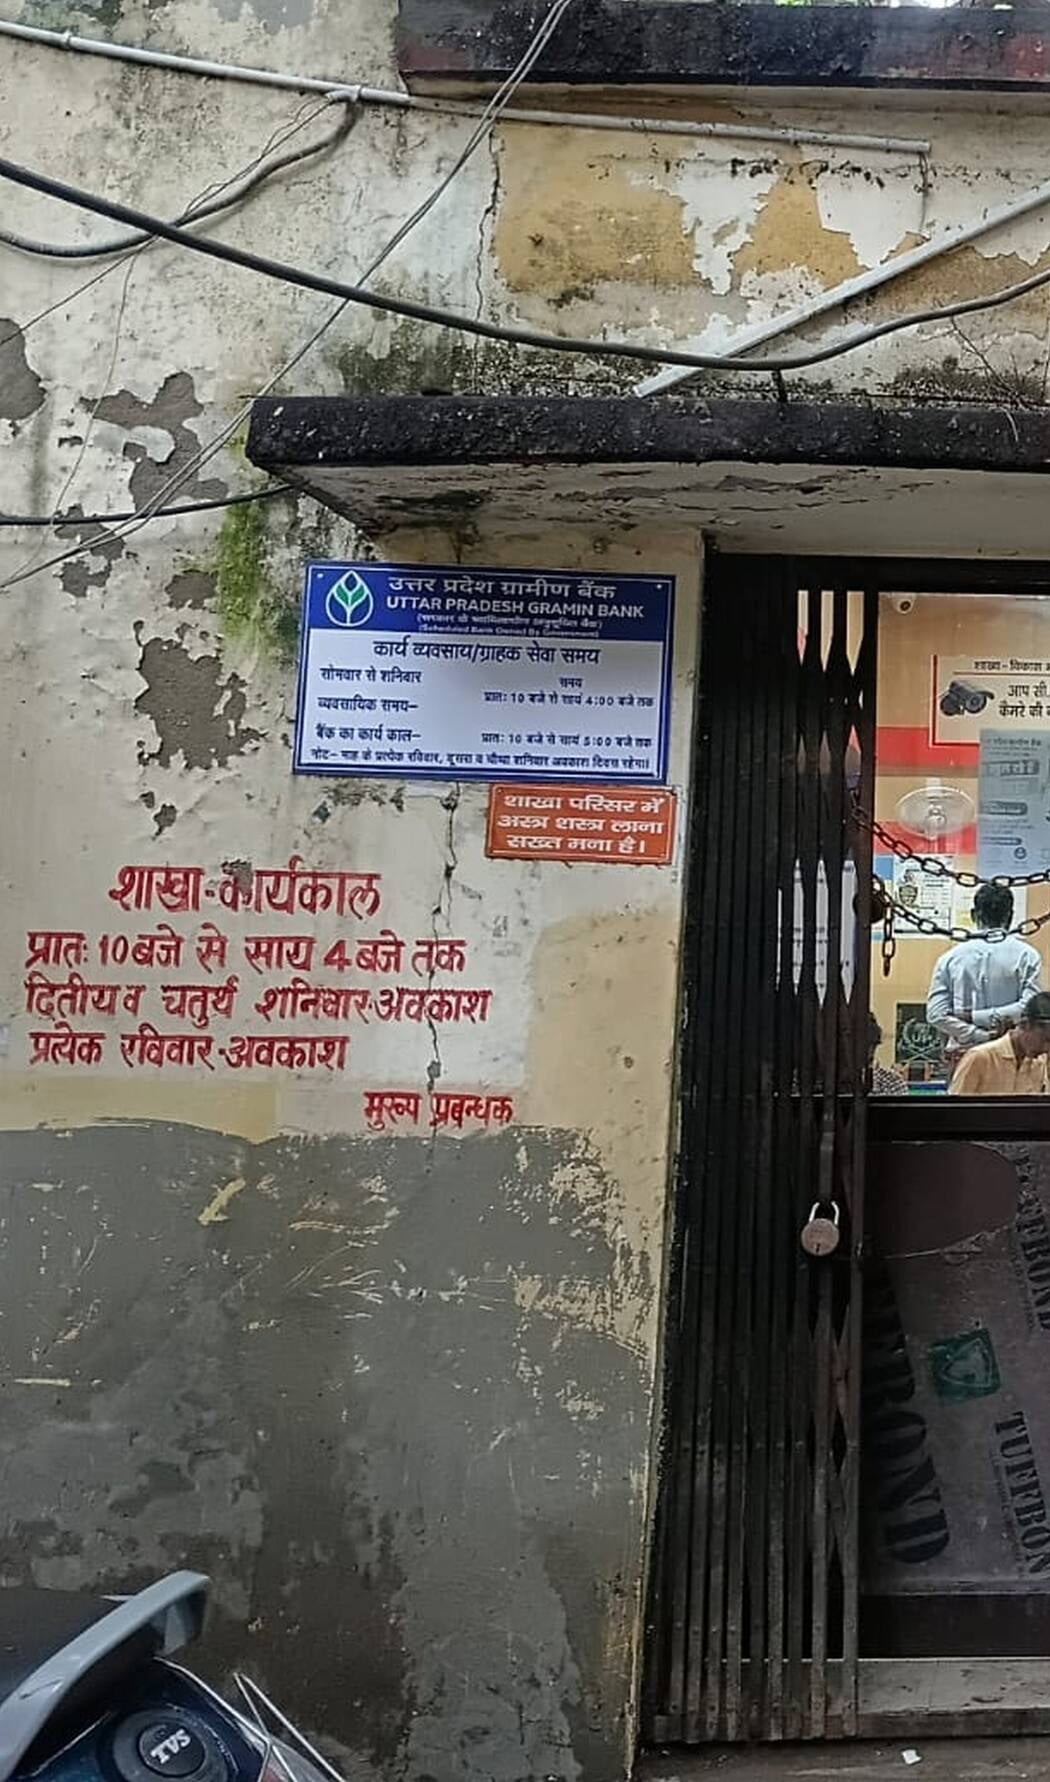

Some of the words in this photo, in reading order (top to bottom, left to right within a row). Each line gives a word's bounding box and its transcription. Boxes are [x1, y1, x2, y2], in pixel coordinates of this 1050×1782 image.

[388, 576, 435, 592] उत्तर
[444, 576, 492, 594] प्रदेश
[501, 578, 570, 598] ग्रामीण
[386, 596, 442, 610] UTTAR
[445, 599, 524, 614] PRADESH
[528, 601, 595, 616] GRAMIN
[597, 604, 645, 618] BANK
[373, 634, 411, 657] कार्य
[413, 640, 521, 663] व्यवसाय/ग्राहक
[527, 640, 554, 663] सेवा
[561, 647, 601, 664] समय
[380, 666, 423, 683] शनिवार
[511, 693, 525, 703] 10
[528, 690, 546, 703] बजे
[585, 696, 614, 706] 4:00
[617, 693, 636, 707] बजे
[1008, 684, 1030, 697] आप
[339, 727, 354, 741] का
[358, 724, 383, 741] कार्य
[509, 733, 522, 744] 10
[526, 731, 544, 744] बजे
[582, 736, 612, 747] 5:00
[615, 734, 634, 748] बजे
[504, 795, 562, 810] शाखा
[569, 794, 637, 812] परिसर
[640, 797, 665, 814] में
[497, 815, 549, 829] अस्त्र
[555, 817, 606, 831] शस्त्र
[611, 819, 664, 834] लाना
[506, 834, 562, 849] सख्त
[568, 837, 614, 852] मना
[25, 931, 88, 968] प्रातः
[196, 922, 228, 974] से
[411, 939, 467, 977] तक
[161, 974, 239, 1029] चतुर्थ
[28, 1021, 106, 1065] प्रत्येक
[364, 1091, 422, 1131] मुख्य
[429, 1092, 513, 1129] प्रबन्धक
[150, 1729, 191, 1764] TVS
